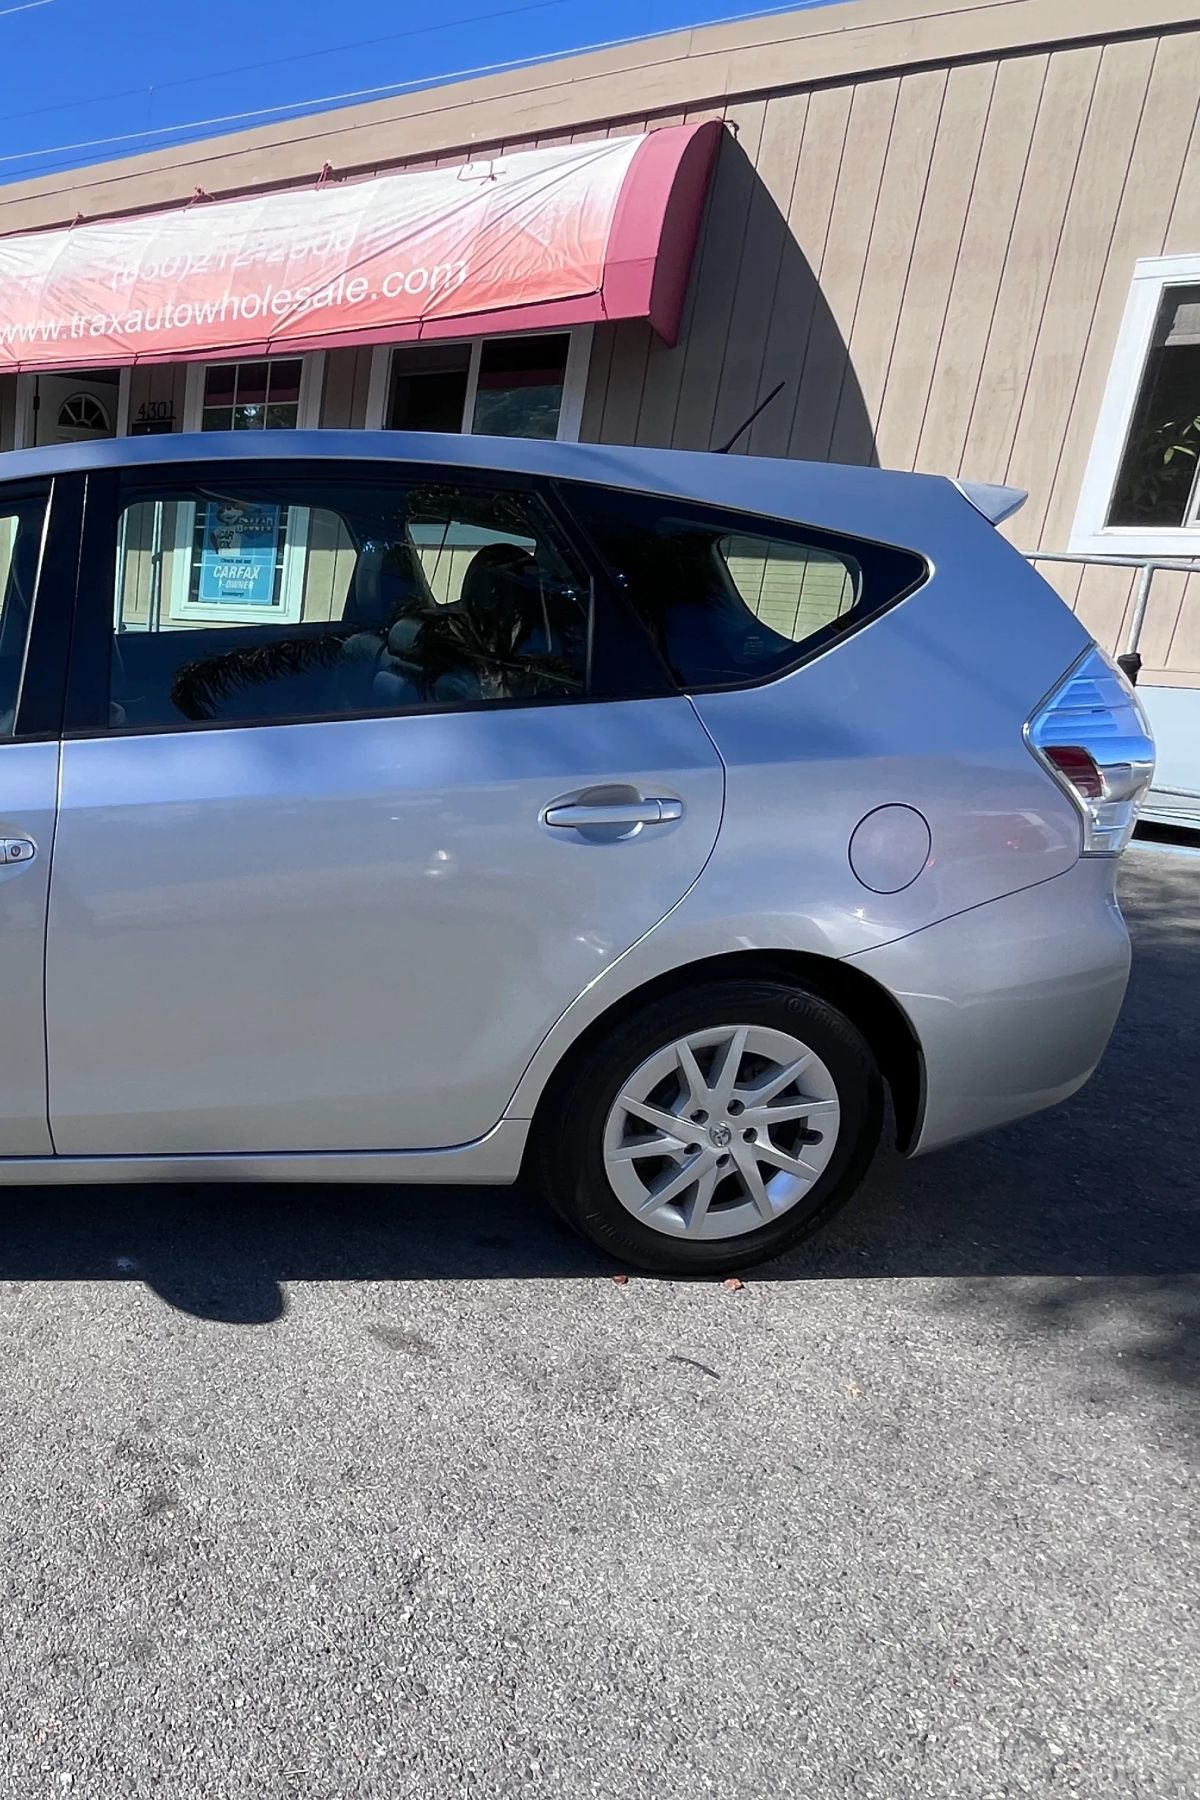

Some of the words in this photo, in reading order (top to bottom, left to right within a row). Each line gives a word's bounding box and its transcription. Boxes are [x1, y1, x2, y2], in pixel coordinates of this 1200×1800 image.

[136, 400, 174, 420] 4301
[213, 565, 260, 580] CARFAX
[218, 580, 255, 590] 1-OWNER
